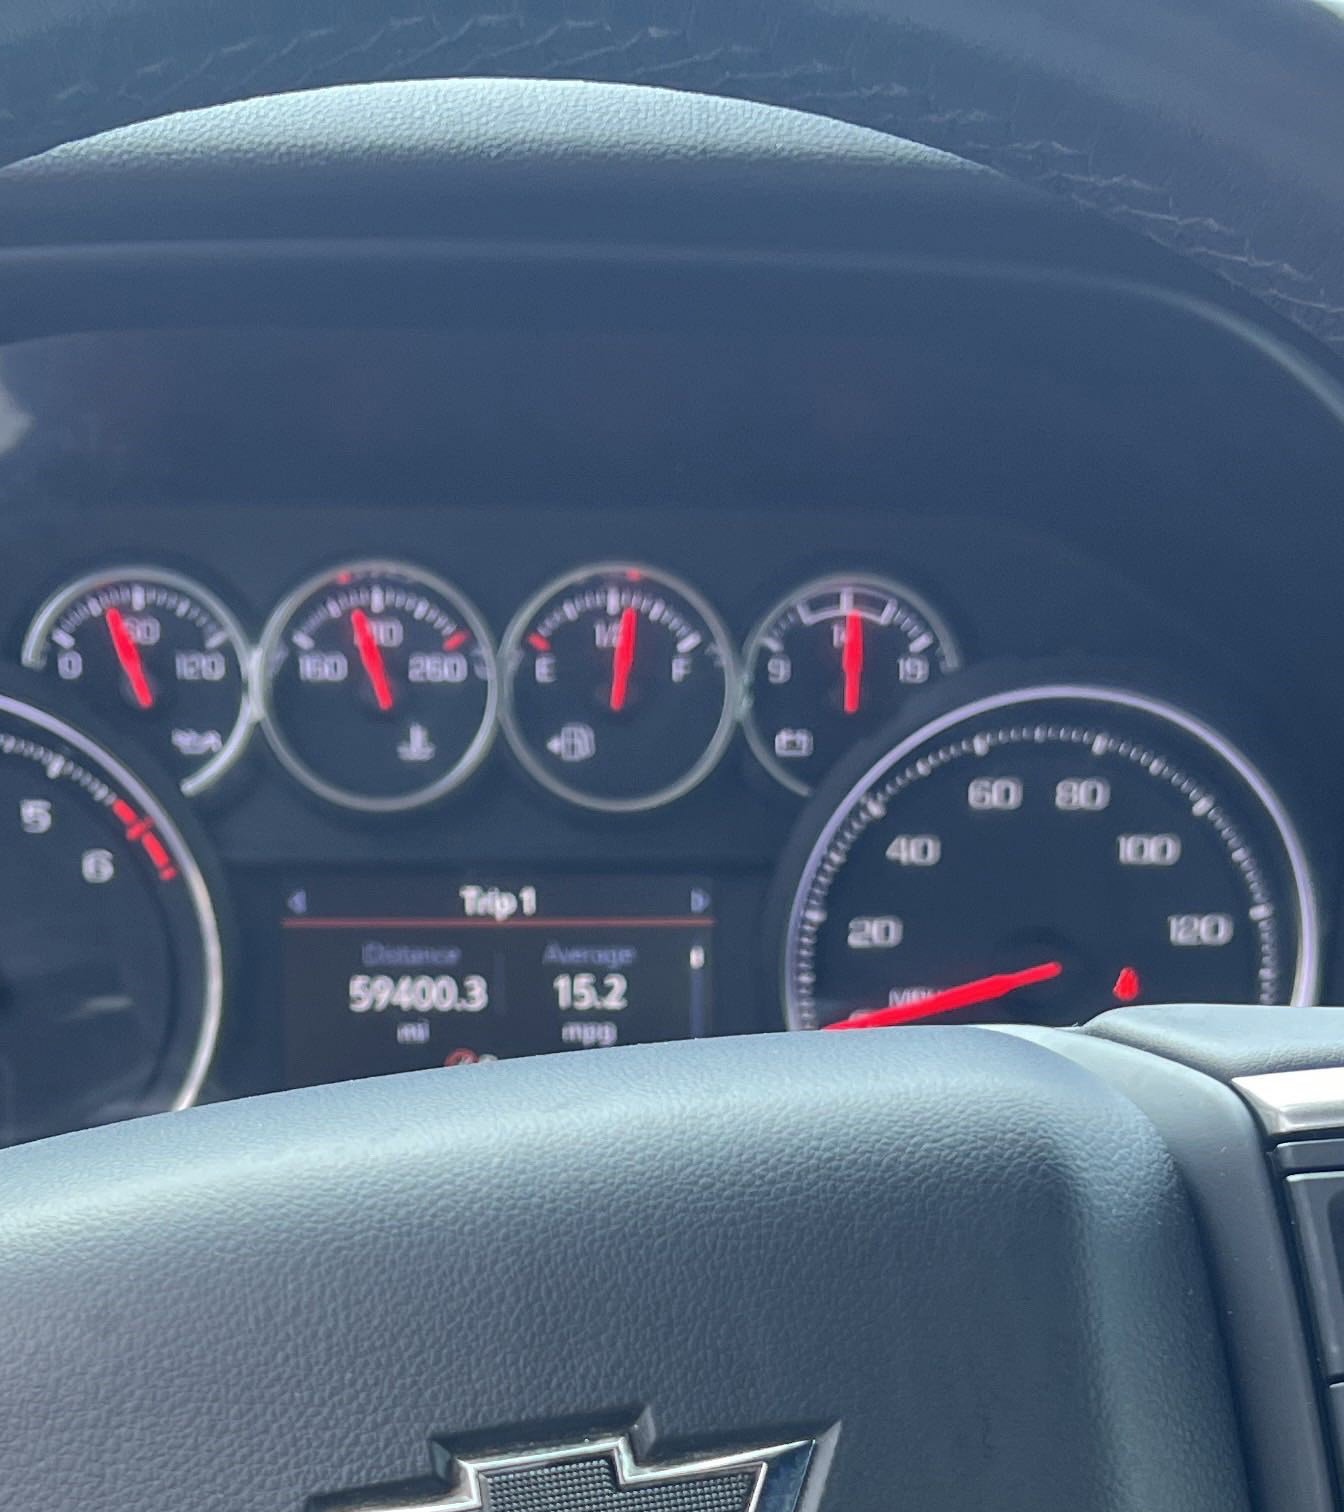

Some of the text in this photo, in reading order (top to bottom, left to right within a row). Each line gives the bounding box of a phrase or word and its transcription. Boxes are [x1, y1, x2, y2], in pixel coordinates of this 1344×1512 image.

[358, 618, 403, 647] 10
[58, 652, 82, 679] 0
[175, 652, 225, 680] 120
[408, 652, 467, 681] 260
[672, 655, 691, 682] F
[767, 655, 791, 684] 9
[897, 655, 929, 684] 19
[968, 779, 1023, 810] 60
[1055, 778, 1110, 810] 80
[19, 798, 52, 833] 5
[885, 835, 941, 866] 40
[1116, 834, 1181, 866] 100
[81, 848, 115, 883] 6
[459, 885, 537, 920] Trip 1
[847, 917, 903, 948] 20
[1168, 914, 1233, 946] 120
[361, 944, 461, 966] Distance
[543, 944, 636, 968] Average
[348, 974, 488, 1012] 59400.3
[553, 974, 628, 1010] 15.2
[396, 1020, 429, 1044] mi
[562, 1021, 617, 1046] mpg
